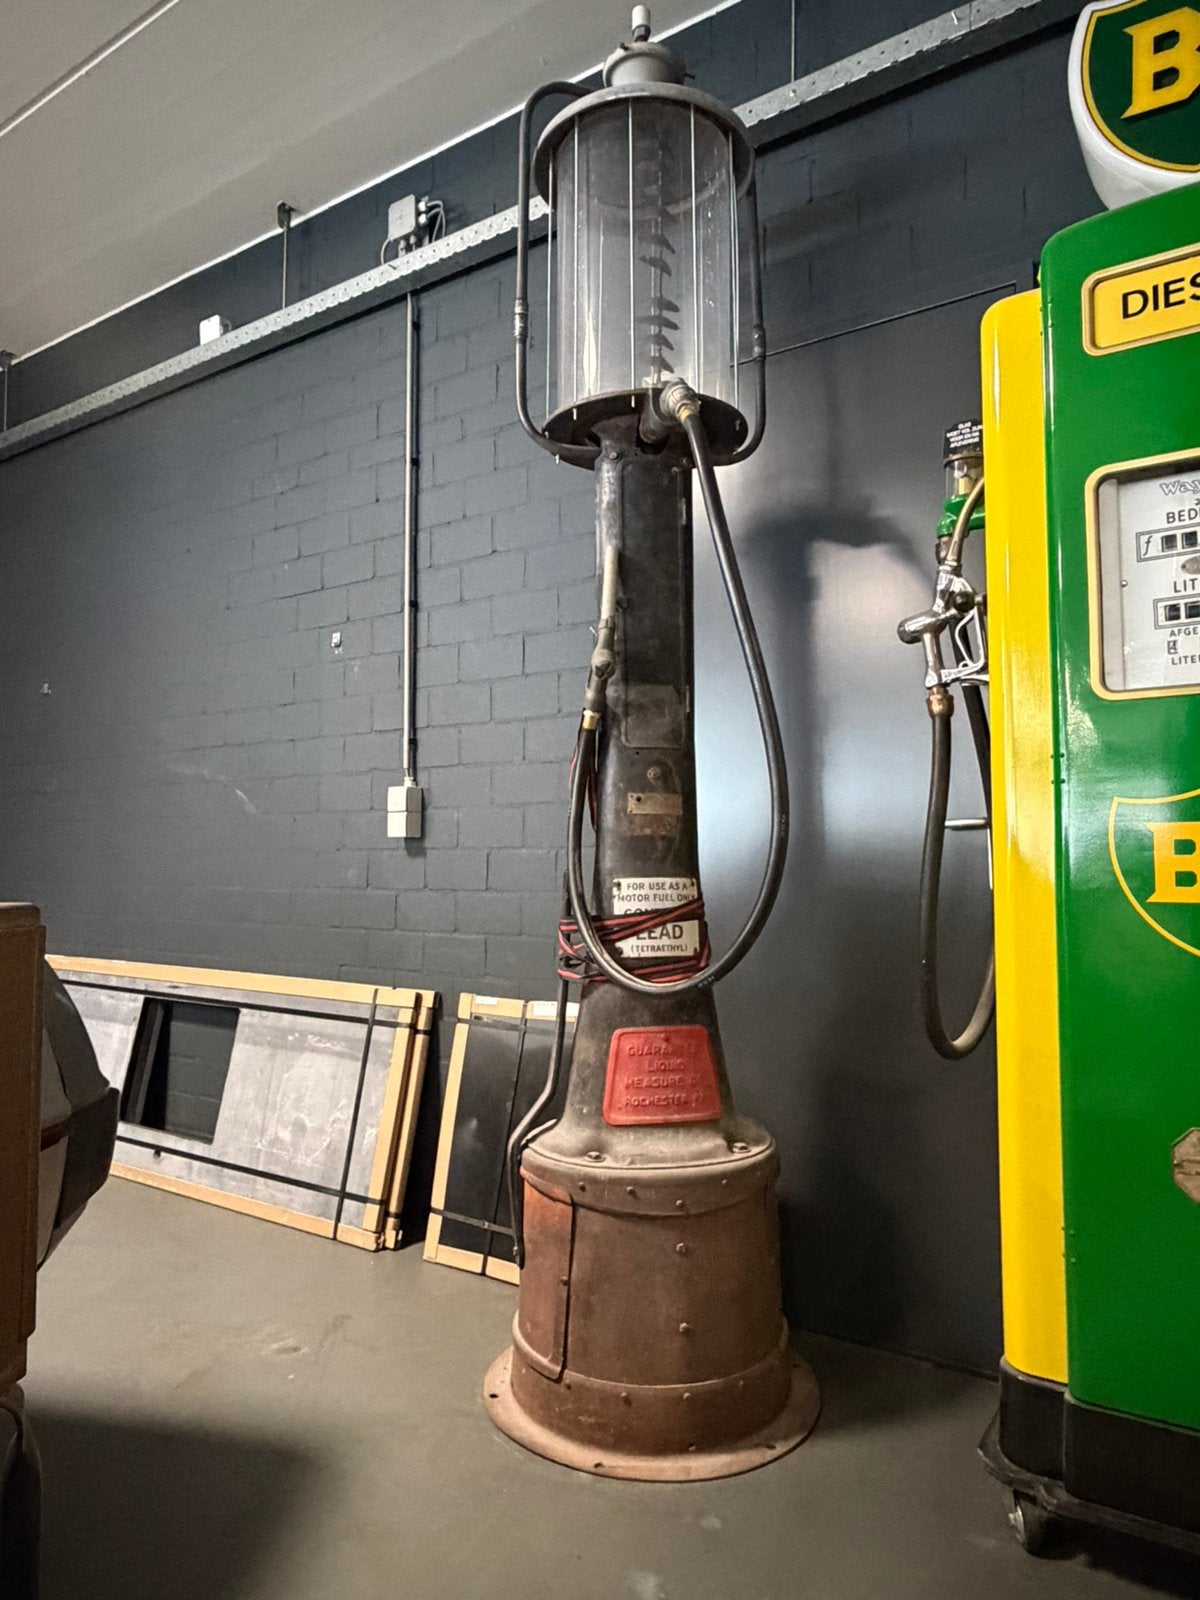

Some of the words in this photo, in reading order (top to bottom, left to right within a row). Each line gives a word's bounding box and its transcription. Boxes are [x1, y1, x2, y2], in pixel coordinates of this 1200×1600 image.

[1166, 508, 1200, 524] BED
[1171, 655, 1200, 666] LITE
[626, 882, 645, 891] FOR
[648, 881, 666, 891] USE
[668, 881, 680, 890] AS
[681, 882, 689, 890] A
[617, 893, 650, 903] MOTOR
[653, 894, 675, 902] FUEL
[636, 924, 684, 940] LEAD
